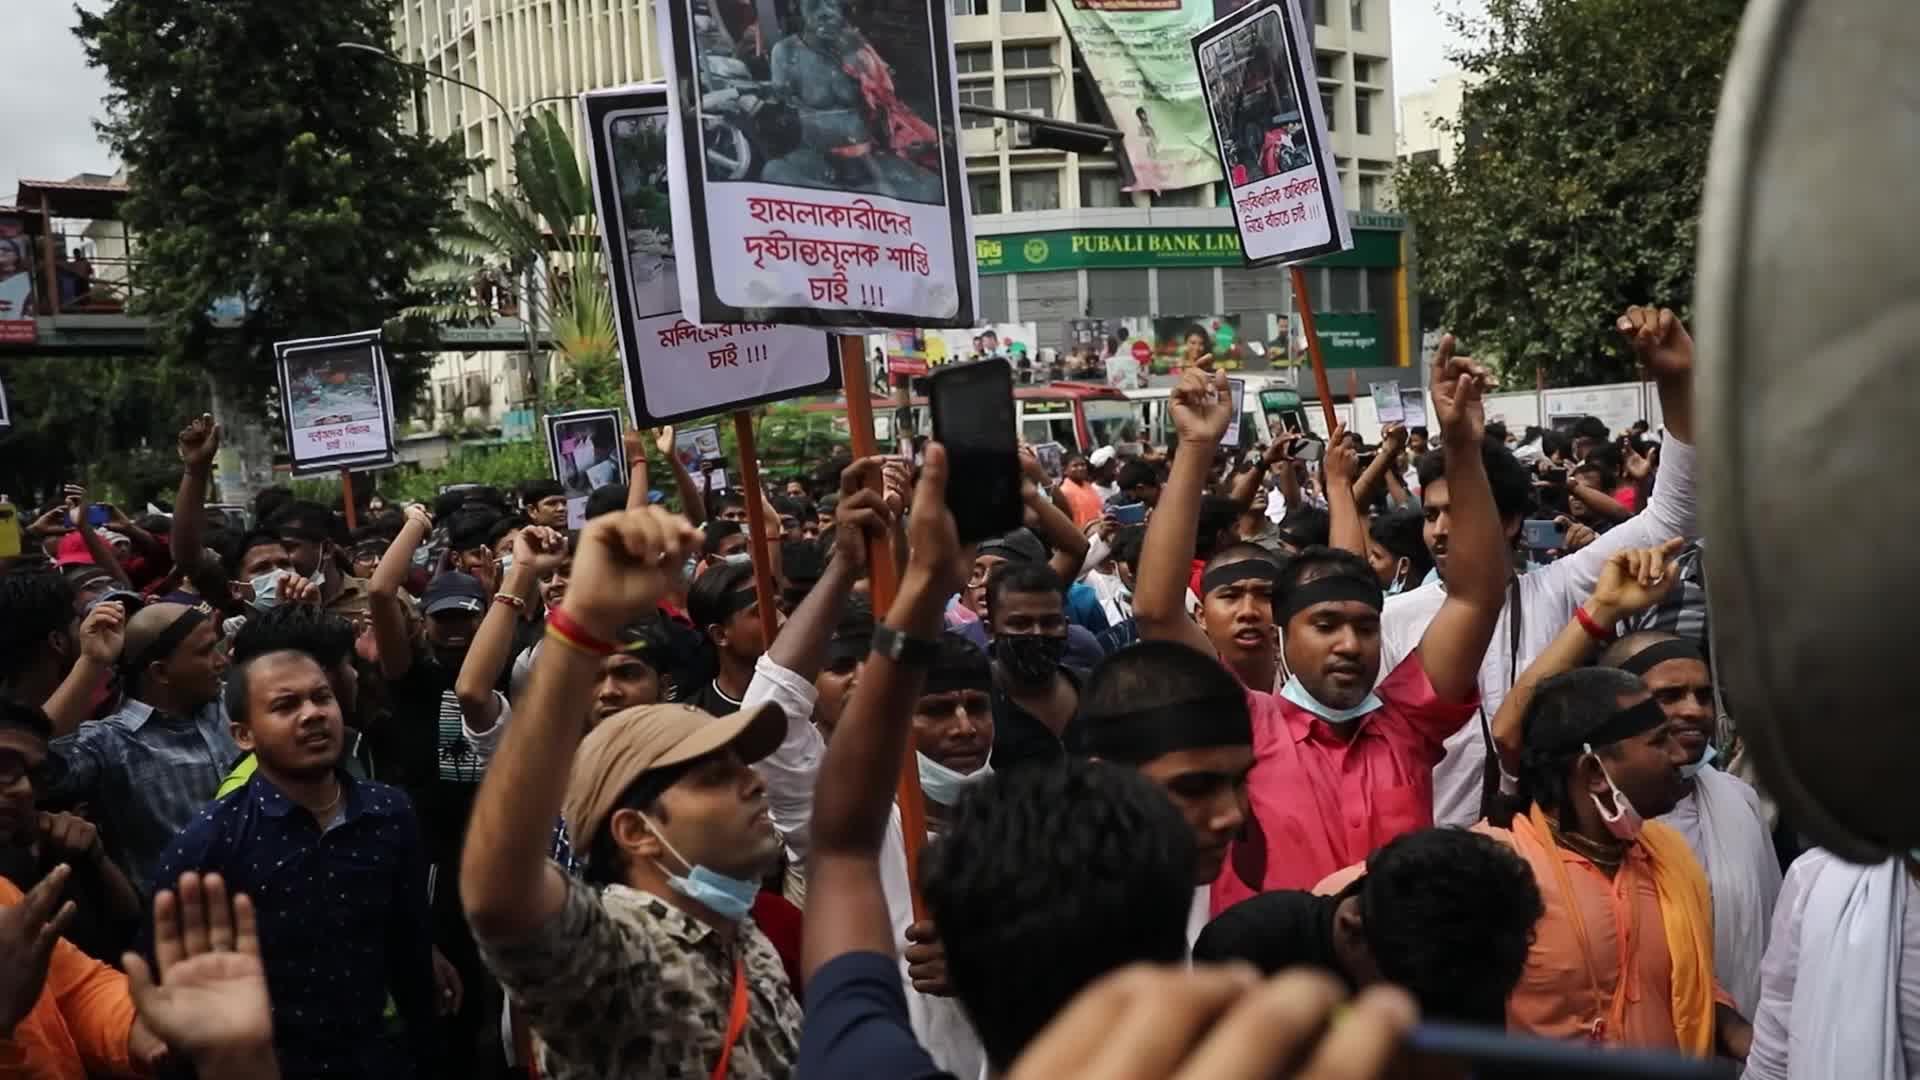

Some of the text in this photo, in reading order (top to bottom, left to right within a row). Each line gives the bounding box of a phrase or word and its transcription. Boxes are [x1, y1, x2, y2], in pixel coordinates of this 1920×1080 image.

[747, 198, 912, 236] হামলাকারীদের
[1291, 201, 1306, 223] চাই
[744, 230, 930, 276] দৃষ্টান্তমূলক শাস্তি
[1072, 234, 1241, 253] PUBALI BANK LIM
[808, 272, 884, 307] চাই !!!
[708, 342, 767, 369] চাই !!!
